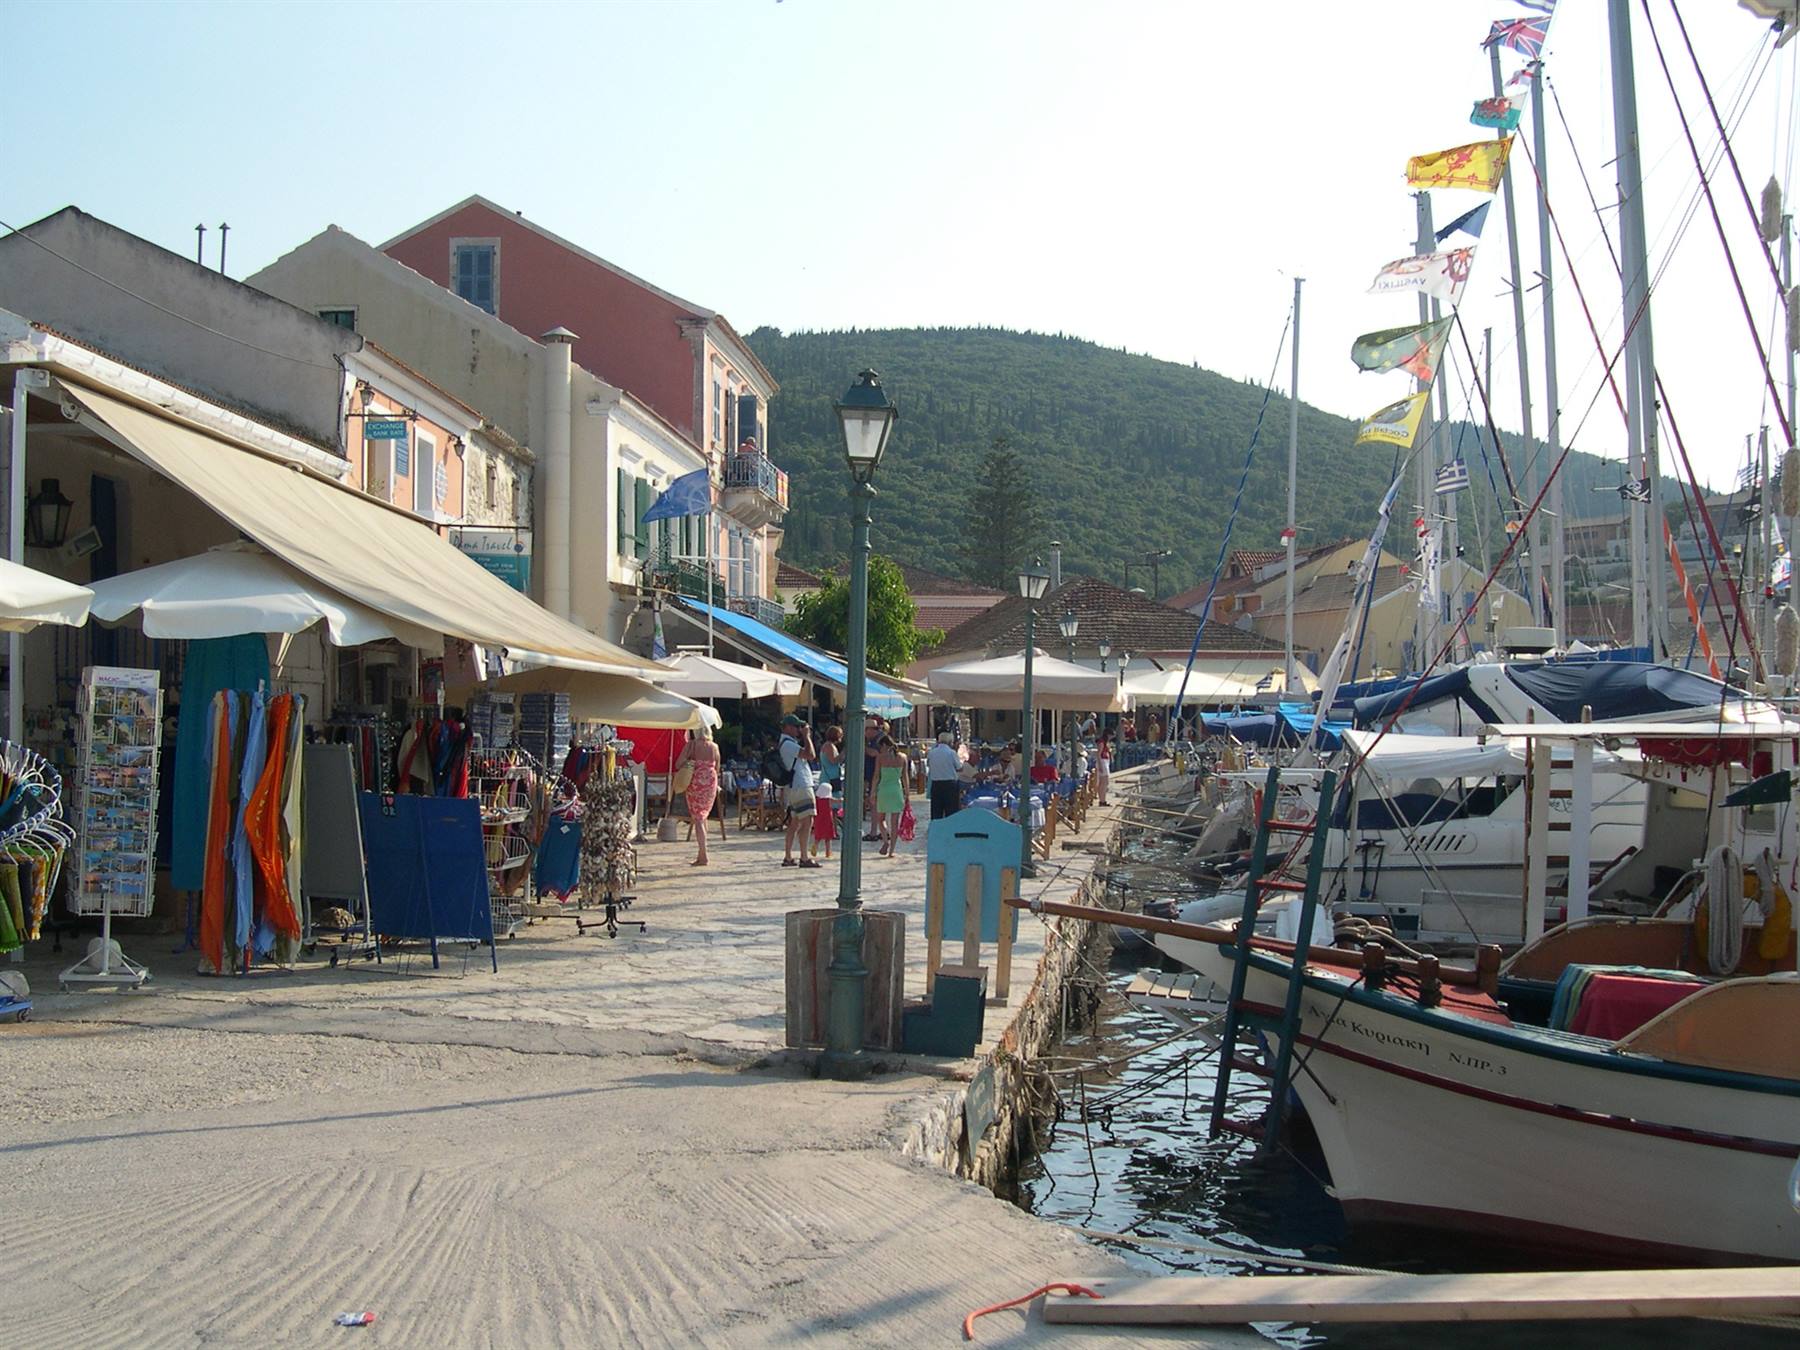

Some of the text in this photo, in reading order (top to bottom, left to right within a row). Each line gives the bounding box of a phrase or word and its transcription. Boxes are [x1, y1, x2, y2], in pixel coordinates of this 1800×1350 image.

[481, 536, 513, 550] Travel
[1351, 1022, 1430, 1056] Κυριακη
[1498, 1066, 1508, 1076] 3
